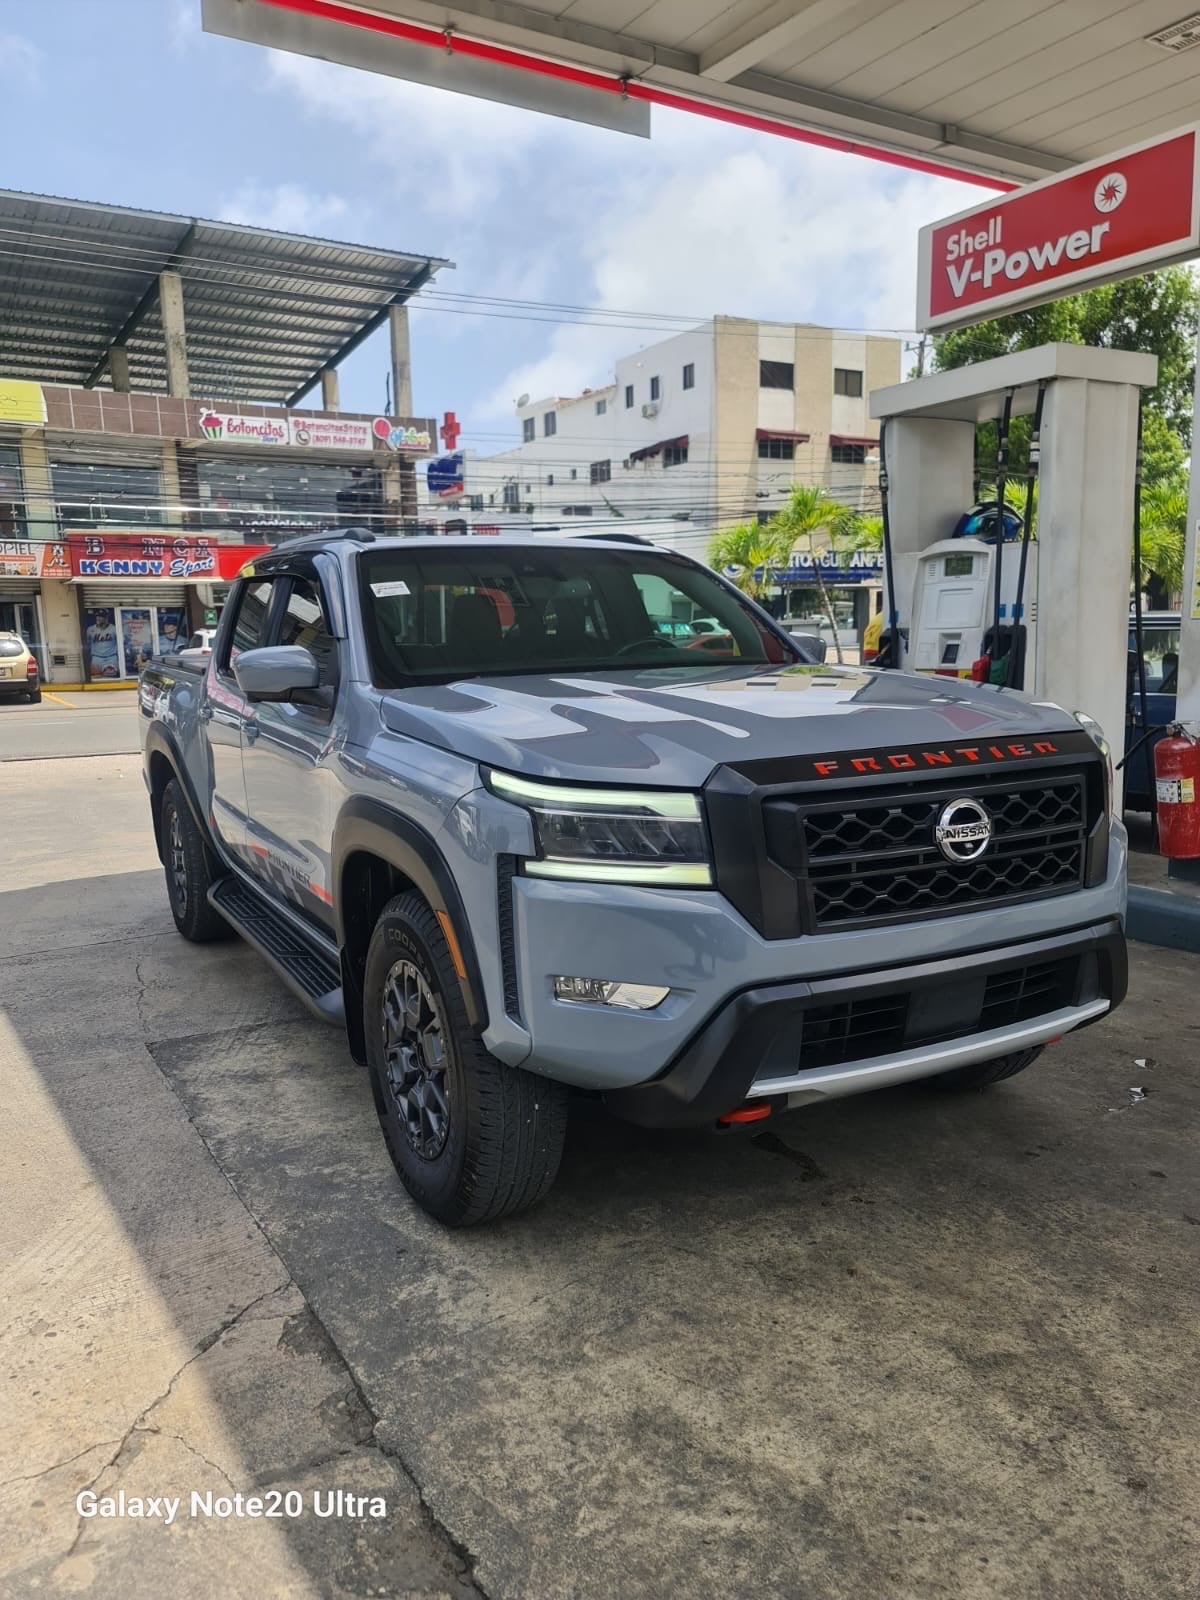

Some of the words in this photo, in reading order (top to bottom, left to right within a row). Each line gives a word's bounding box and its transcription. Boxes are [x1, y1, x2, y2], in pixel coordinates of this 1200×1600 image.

[946, 215, 1002, 261] Shell
[946, 221, 1110, 298] V-Power
[227, 418, 285, 438] Botoncitos
[79, 559, 164, 575] KENNY
[170, 557, 215, 577] Sport
[812, 740, 1059, 777] FRONTIER
[945, 823, 990, 839] NISSAN
